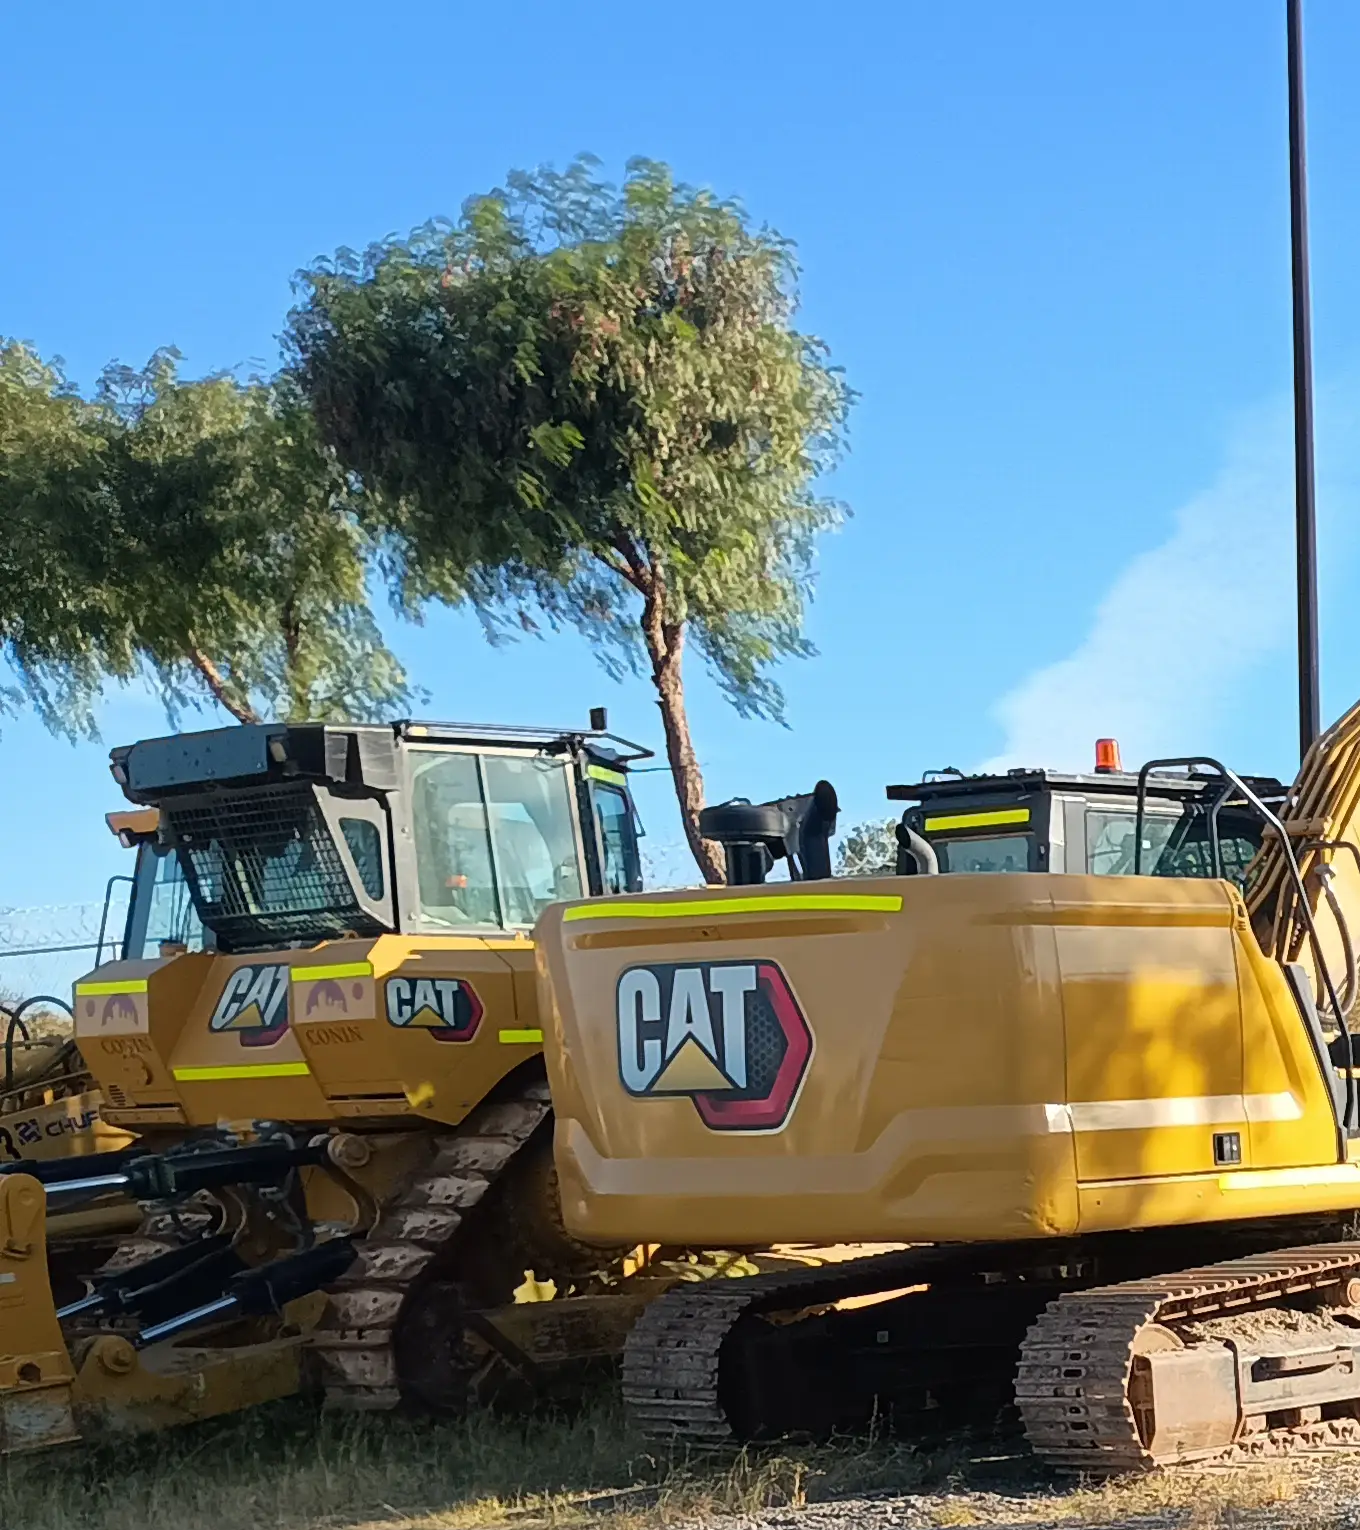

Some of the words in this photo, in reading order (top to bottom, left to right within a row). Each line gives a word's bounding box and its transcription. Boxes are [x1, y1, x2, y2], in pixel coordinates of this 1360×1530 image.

[386, 978, 459, 1026] CAT
[305, 1026, 365, 1046] CONIN
[618, 965, 757, 1092] CAT
